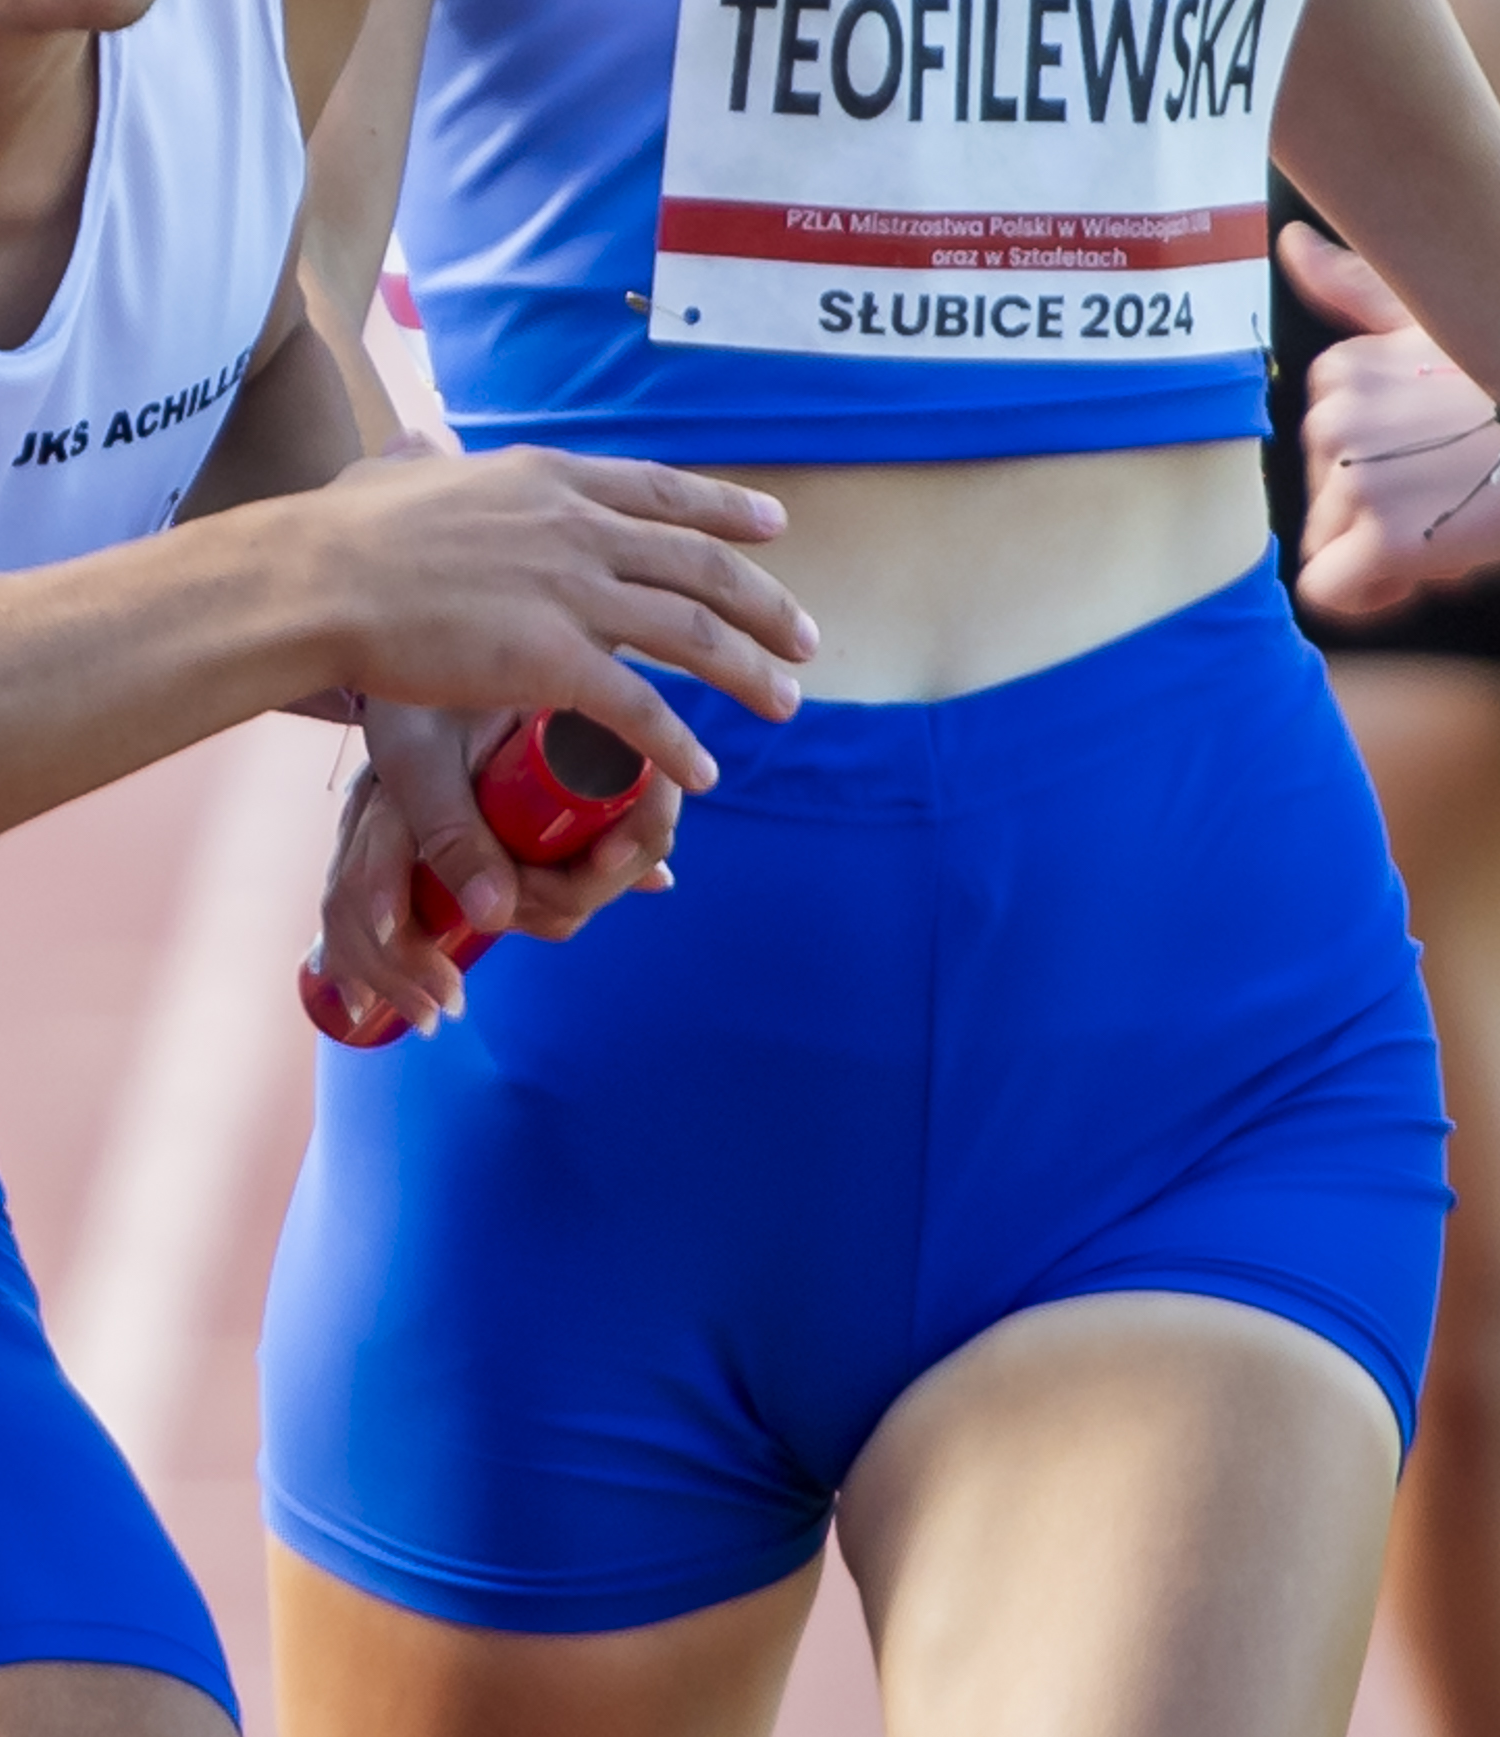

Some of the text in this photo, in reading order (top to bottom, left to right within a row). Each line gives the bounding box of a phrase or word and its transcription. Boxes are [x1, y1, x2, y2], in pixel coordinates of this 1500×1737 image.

[786, 208, 843, 233] PZLA
[848, 213, 984, 238] Mistrzostwa
[989, 216, 1052, 238] Polski
[1056, 220, 1078, 239] w
[931, 245, 1128, 268] oraz w Sztafetach
[818, 289, 1195, 339] SŁUBICE 2024
